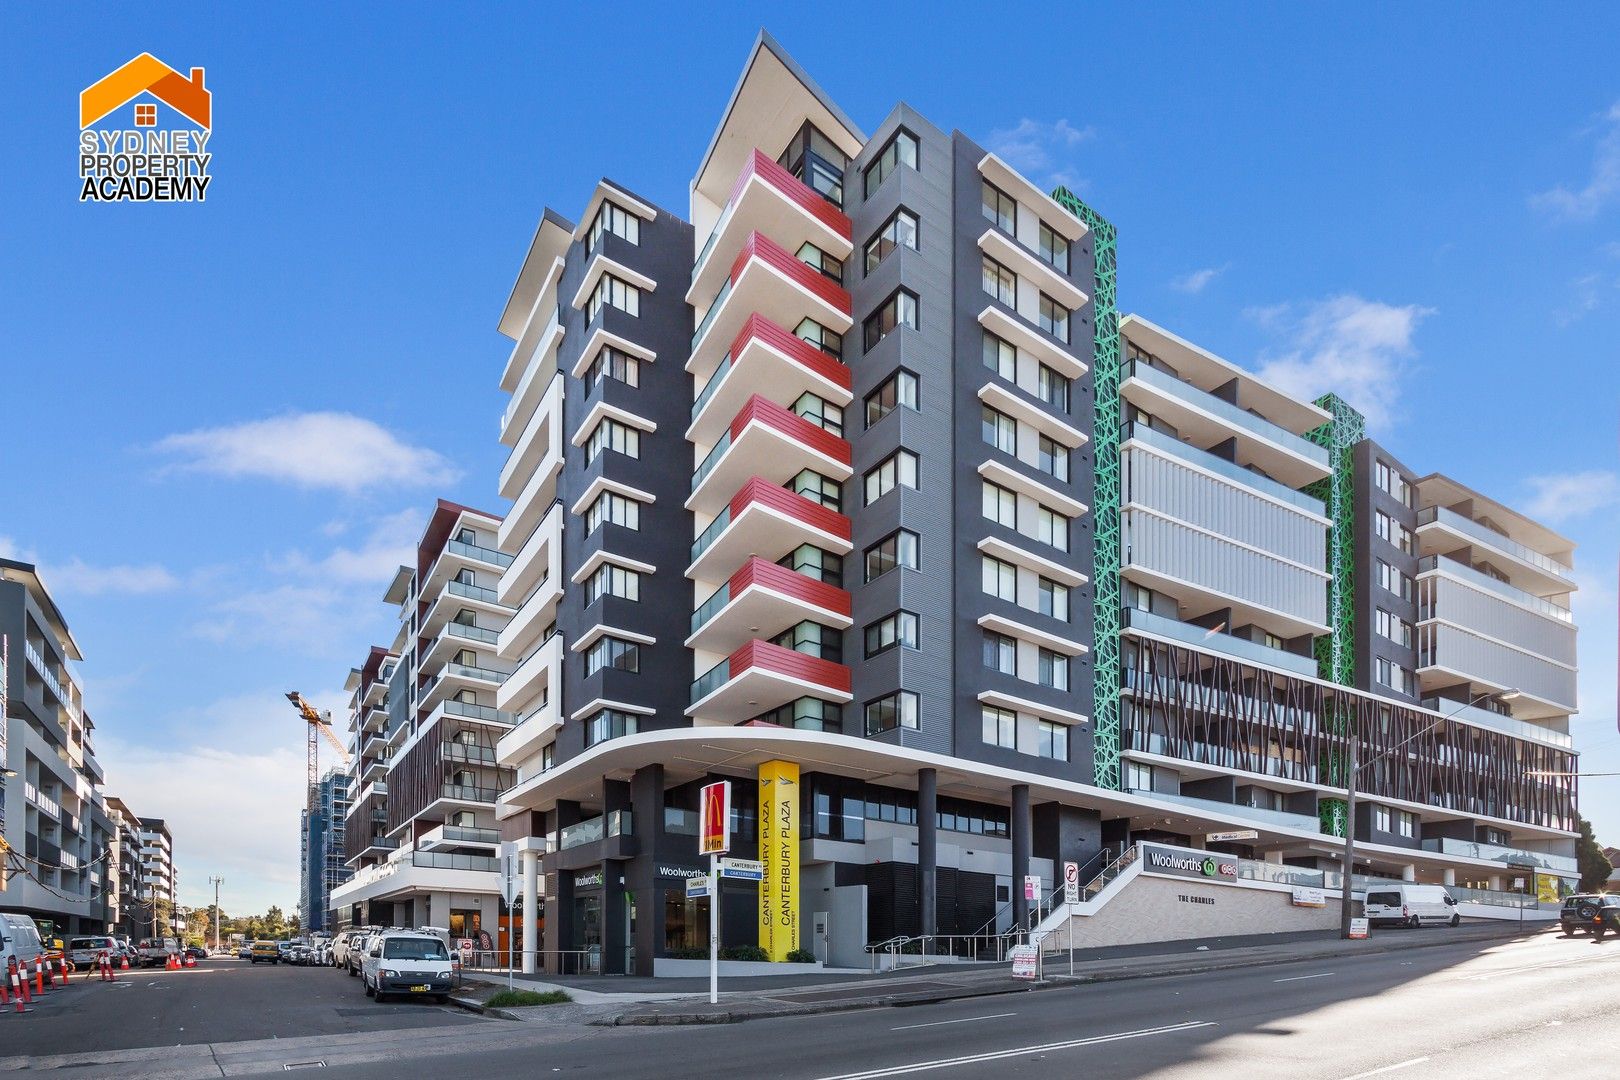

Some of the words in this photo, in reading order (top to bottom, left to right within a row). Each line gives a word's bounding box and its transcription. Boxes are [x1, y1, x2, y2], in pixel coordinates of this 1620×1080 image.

[762, 800, 770, 840] PLAZA
[781, 800, 791, 838] PLAZA
[731, 862, 758, 870] CANTERBURY
[1151, 852, 1202, 872] Woolworths
[575, 874, 599, 887] Woolworths
[659, 867, 707, 878] Woolworths
[762, 843, 770, 926] CANTERBURY
[781, 842, 791, 926] CANTERBURY
[1178, 894, 1189, 903] THE
[1190, 896, 1215, 905] CHARLES
